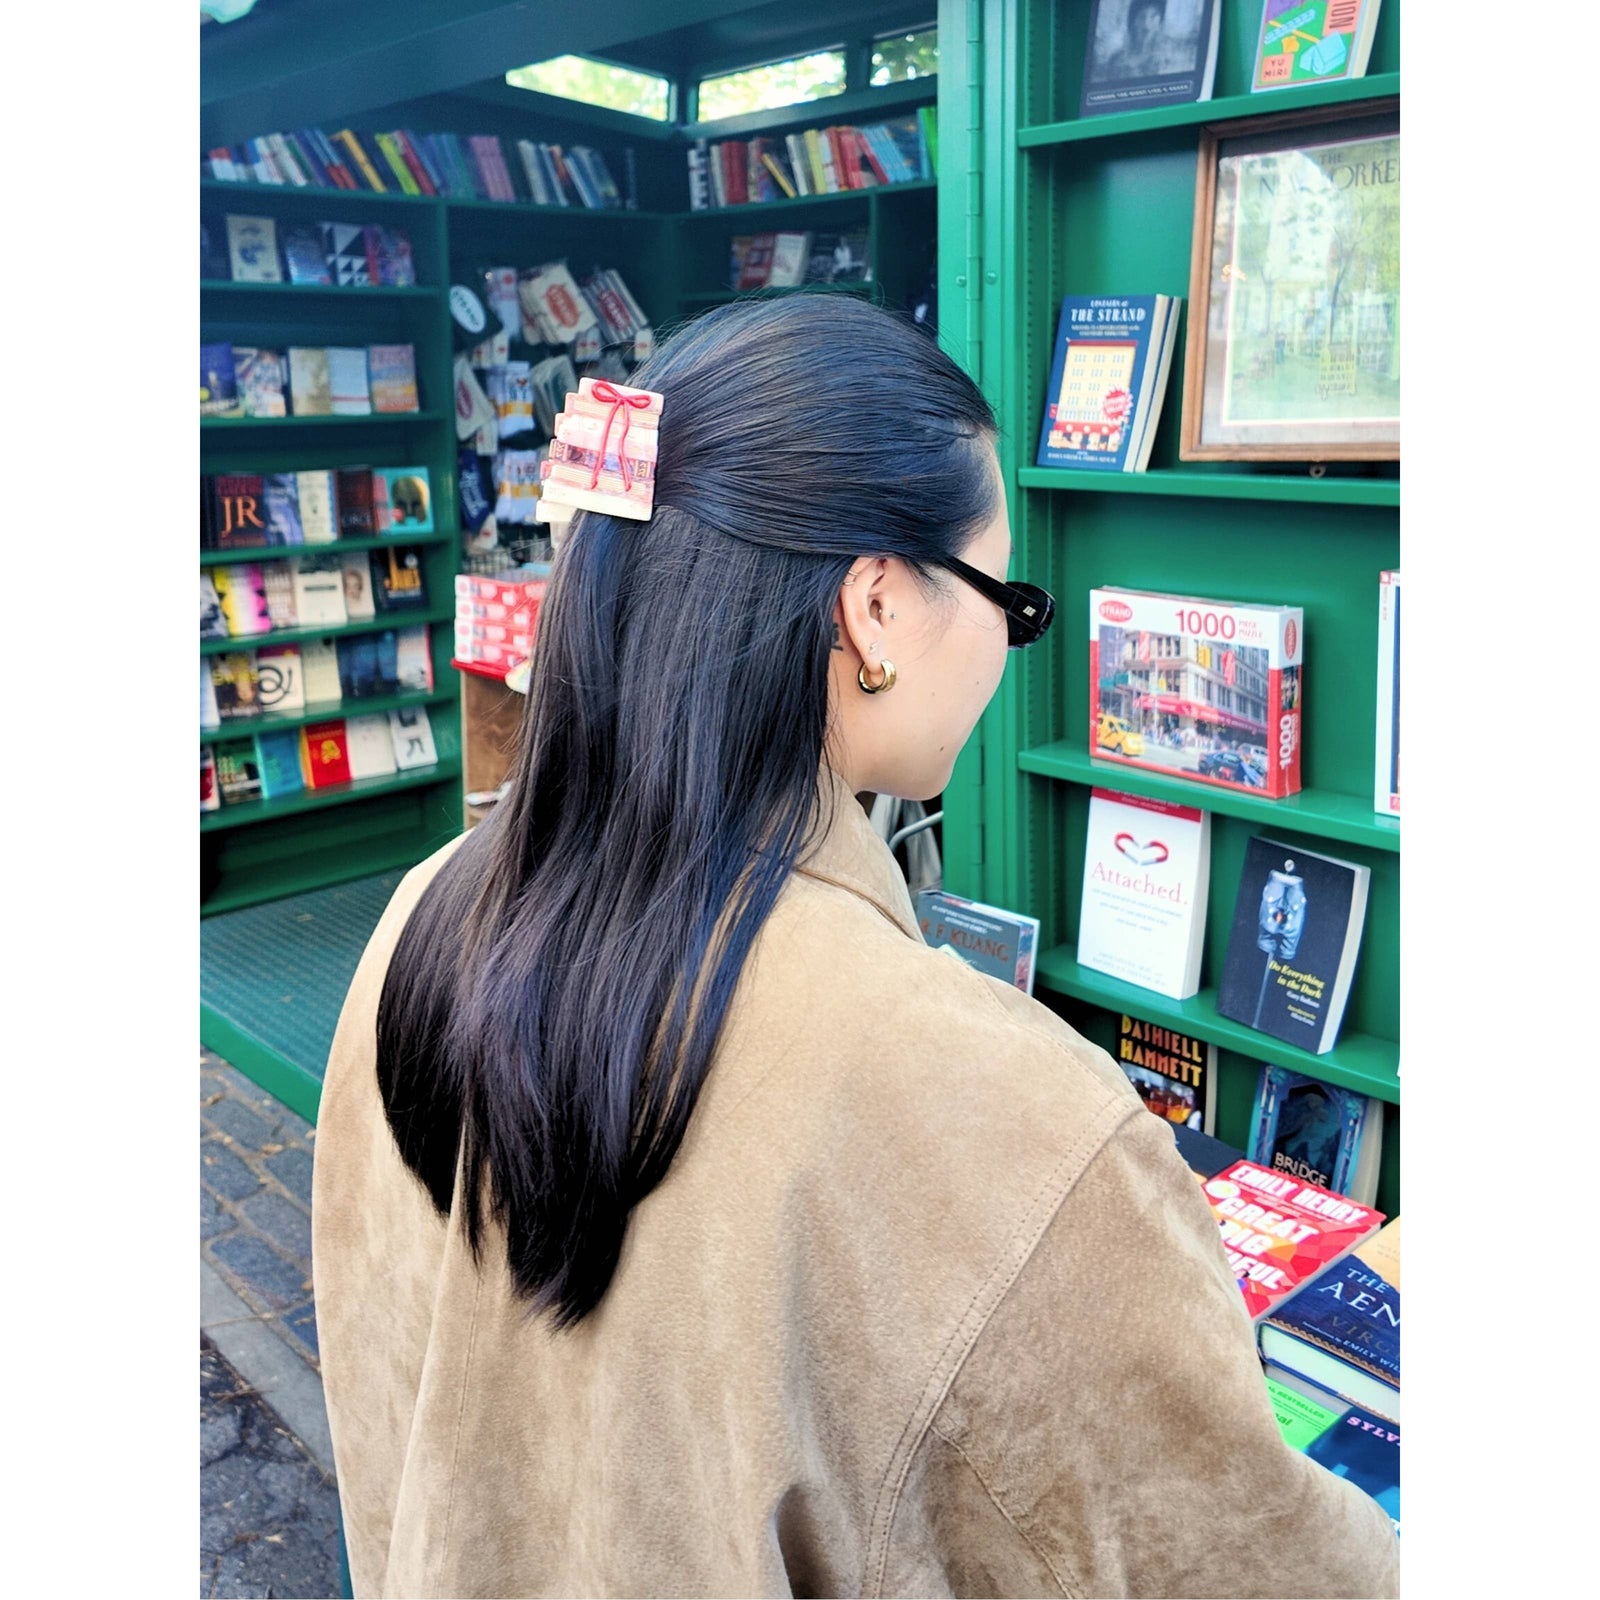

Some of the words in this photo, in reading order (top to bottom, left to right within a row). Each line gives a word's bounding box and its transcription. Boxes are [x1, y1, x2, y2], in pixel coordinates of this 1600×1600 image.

[1071, 308, 1094, 322] THE
[1098, 307, 1146, 322] STRAND
[220, 496, 265, 538] JR
[1100, 603, 1132, 618] STRAND
[1175, 609, 1236, 640] 1000
[1280, 714, 1294, 770] 1000
[1090, 861, 1188, 905] Attached.
[949, 927, 1009, 963] KUANG
[1121, 1014, 1202, 1063] DASHIELL
[1120, 1038, 1202, 1087] HAMMETT
[1274, 1152, 1328, 1190] BRIDGE
[1228, 1165, 1298, 1198] EMILY
[1291, 1188, 1369, 1224] HENRY
[1216, 1197, 1320, 1243] GREAT
[1346, 1268, 1390, 1293] THE
[1343, 1340, 1377, 1358] EMILY
[1276, 1390, 1325, 1419] BESTSELLER
